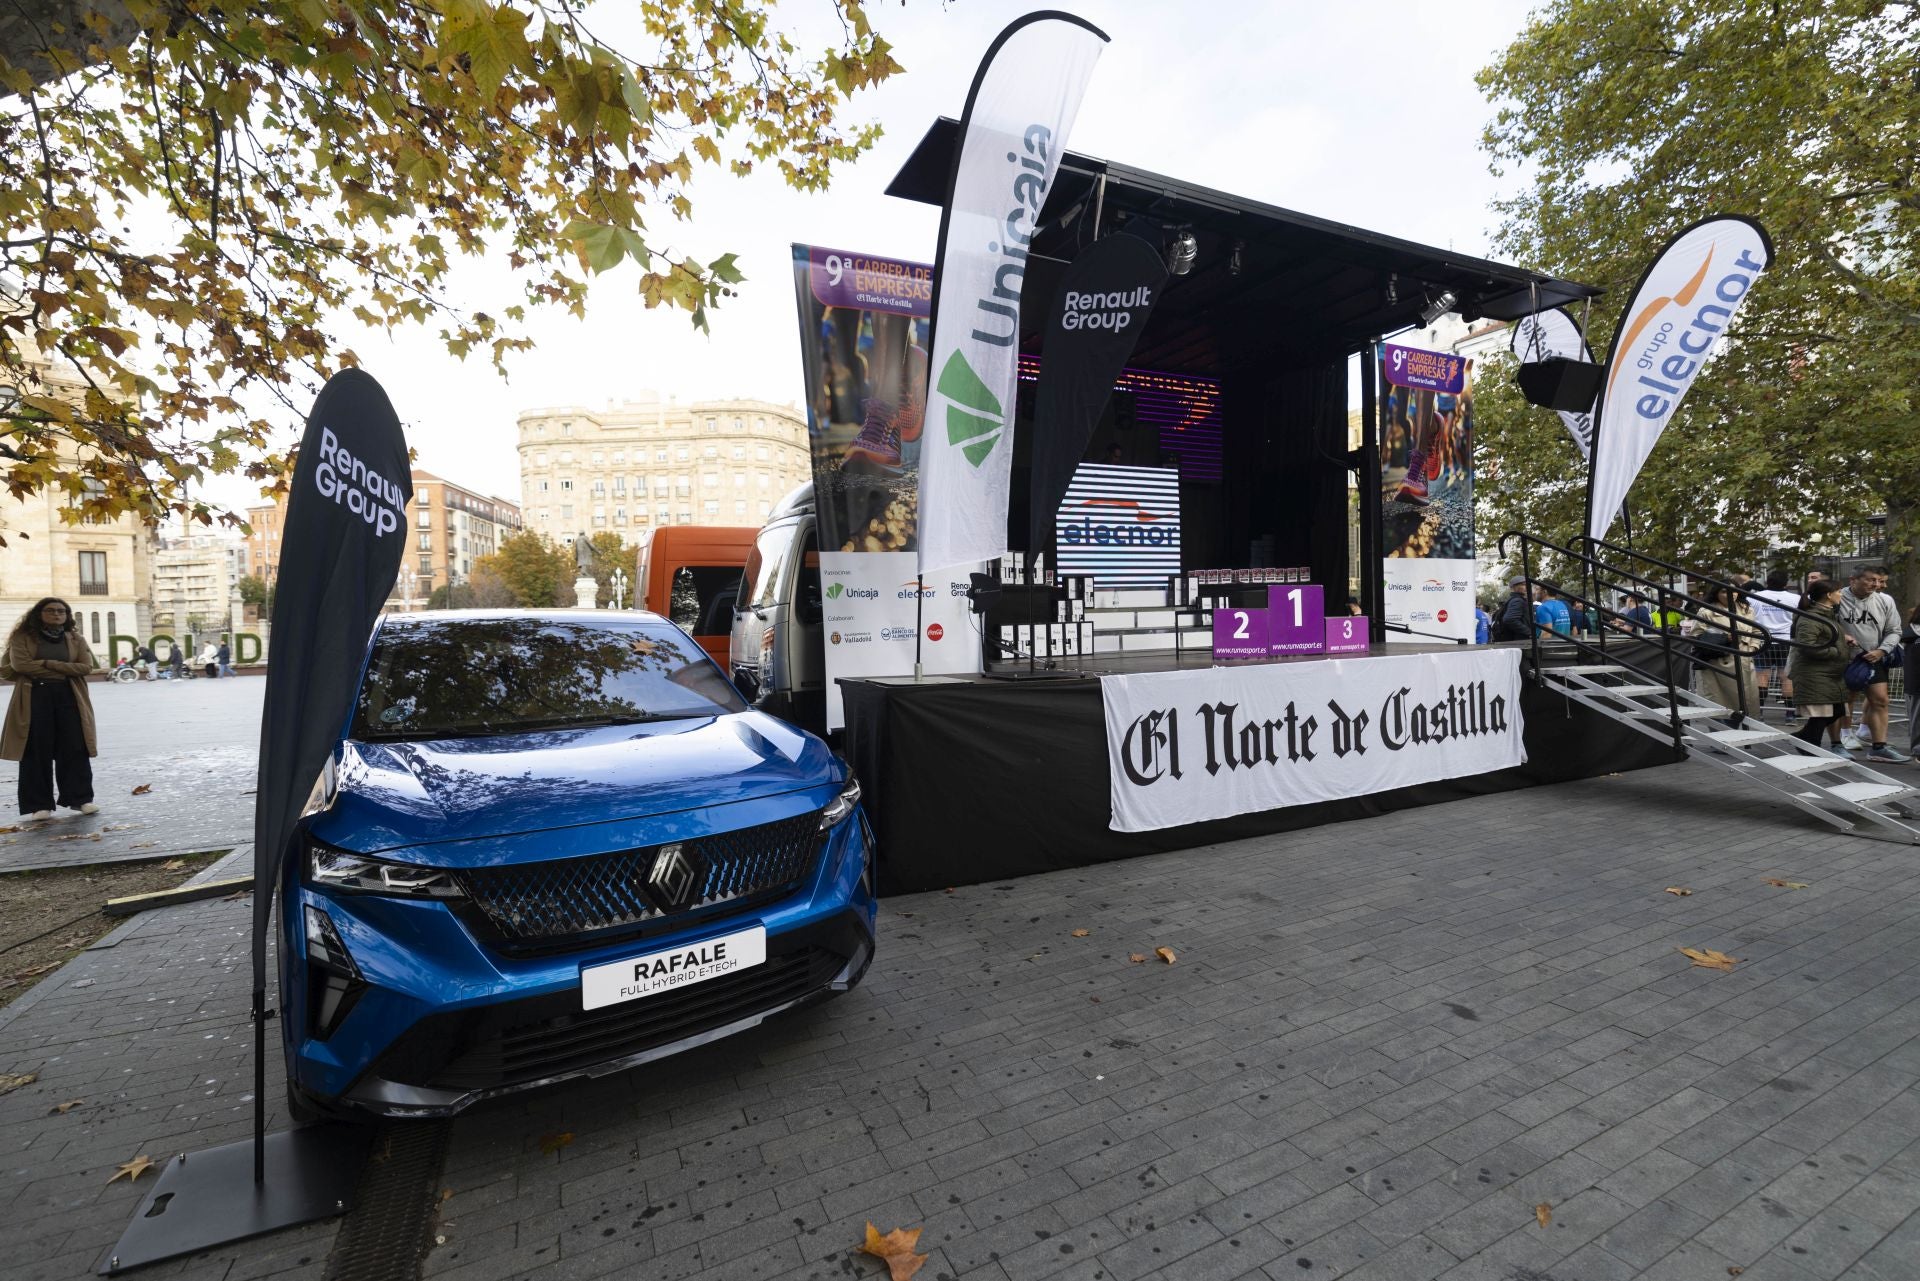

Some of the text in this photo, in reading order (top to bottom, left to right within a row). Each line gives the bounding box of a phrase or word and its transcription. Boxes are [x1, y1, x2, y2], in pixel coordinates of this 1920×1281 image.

[972, 123, 1052, 347] Unicaja
[855, 258, 911, 281] CARRERA
[915, 268, 931, 282] DE
[855, 277, 932, 301] EMPRESAS
[1063, 286, 1152, 312] Renault
[866, 294, 882, 304] Norte
[889, 298, 912, 309] Castilla
[1062, 308, 1131, 334] Group
[1636, 249, 1762, 420] elecnor
[1636, 321, 1673, 369] grupo
[1407, 351, 1437, 366] CARRERA
[1438, 356, 1447, 368] DE
[1407, 362, 1446, 380] EMPRESAS
[315, 462, 397, 537] Group
[1064, 516, 1179, 545] elecnor
[846, 587, 879, 601] Unicaja
[951, 589, 969, 597] Grou
[1388, 583, 1412, 592] Unicaja
[1422, 584, 1445, 592] elecnor
[1287, 588, 1303, 627] 1
[1233, 611, 1250, 639] 2
[1342, 620, 1353, 639] 3
[844, 636, 872, 644] Valladolid
[1216, 646, 1267, 655] www.runvasport.es
[1272, 642, 1323, 652] www.runvasport.es
[1121, 680, 1508, 787] El Norte de Castilla
[633, 943, 727, 982] RAFALE
[620, 959, 738, 998] FULL HYBRID E-TECH
